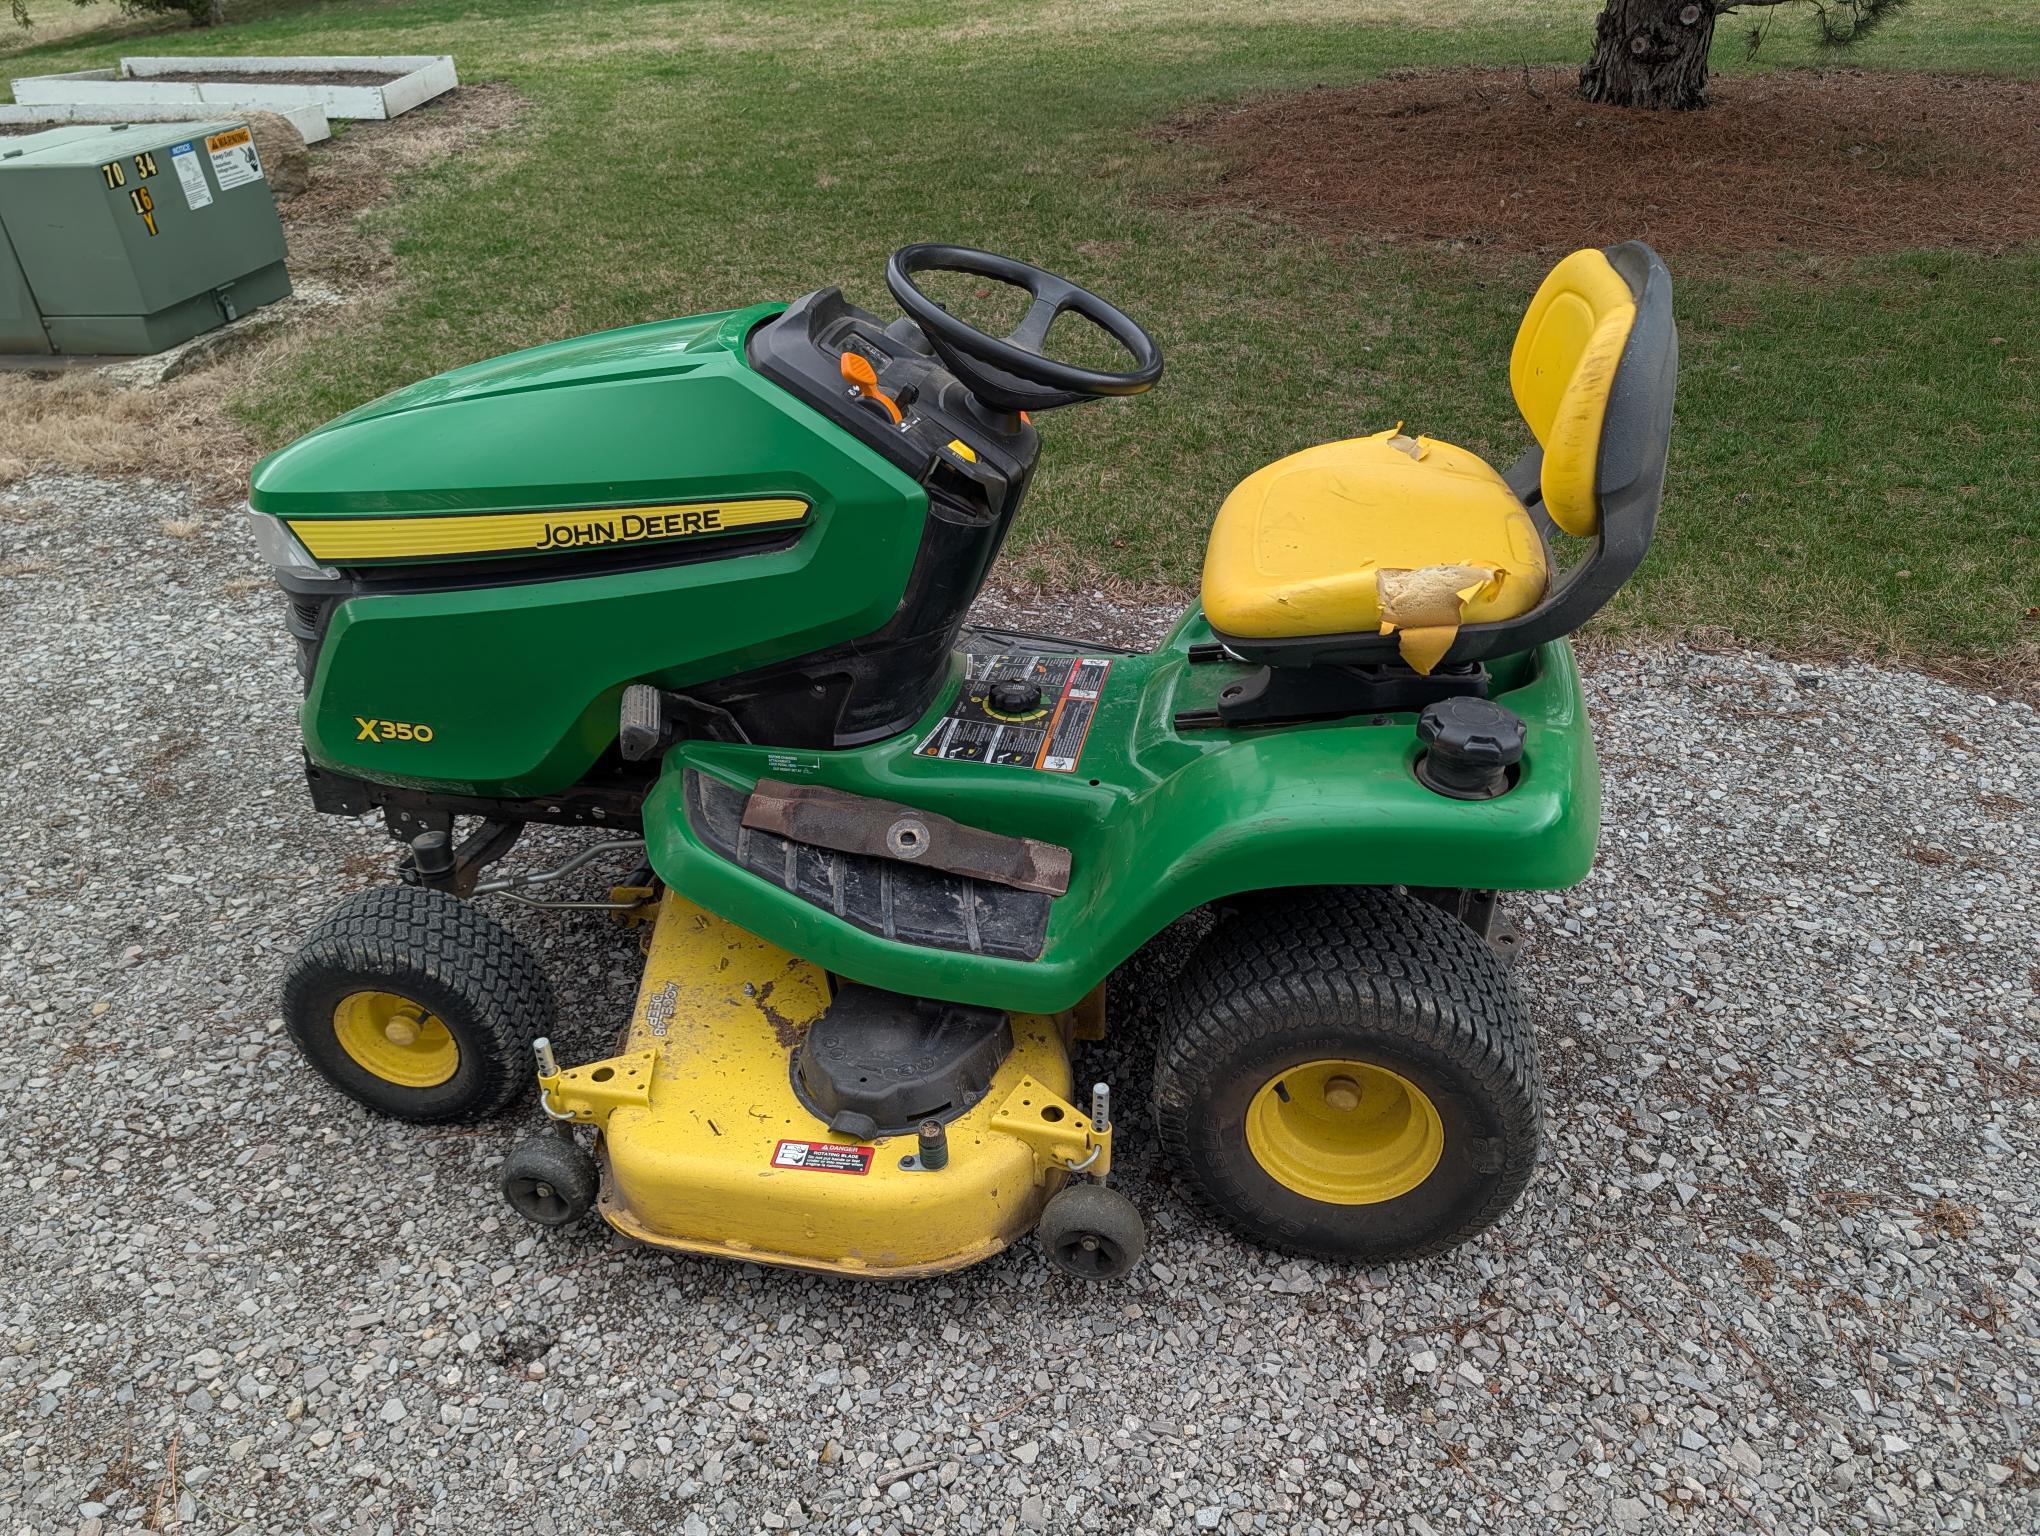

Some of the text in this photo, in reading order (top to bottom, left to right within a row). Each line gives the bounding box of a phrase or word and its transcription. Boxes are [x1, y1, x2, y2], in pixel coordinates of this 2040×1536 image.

[172, 143, 191, 154] NOTICE
[218, 131, 249, 147] WARNING
[102, 153, 158, 189] 70 34
[131, 188, 153, 214] 16
[537, 509, 722, 549] JOHN DEERE
[355, 717, 434, 743] X350
[647, 994, 664, 1027] DEEP
[659, 981, 679, 1021] ACCEL
[813, 1150, 840, 1158] ROTATING
[829, 1144, 858, 1153] DANGER
